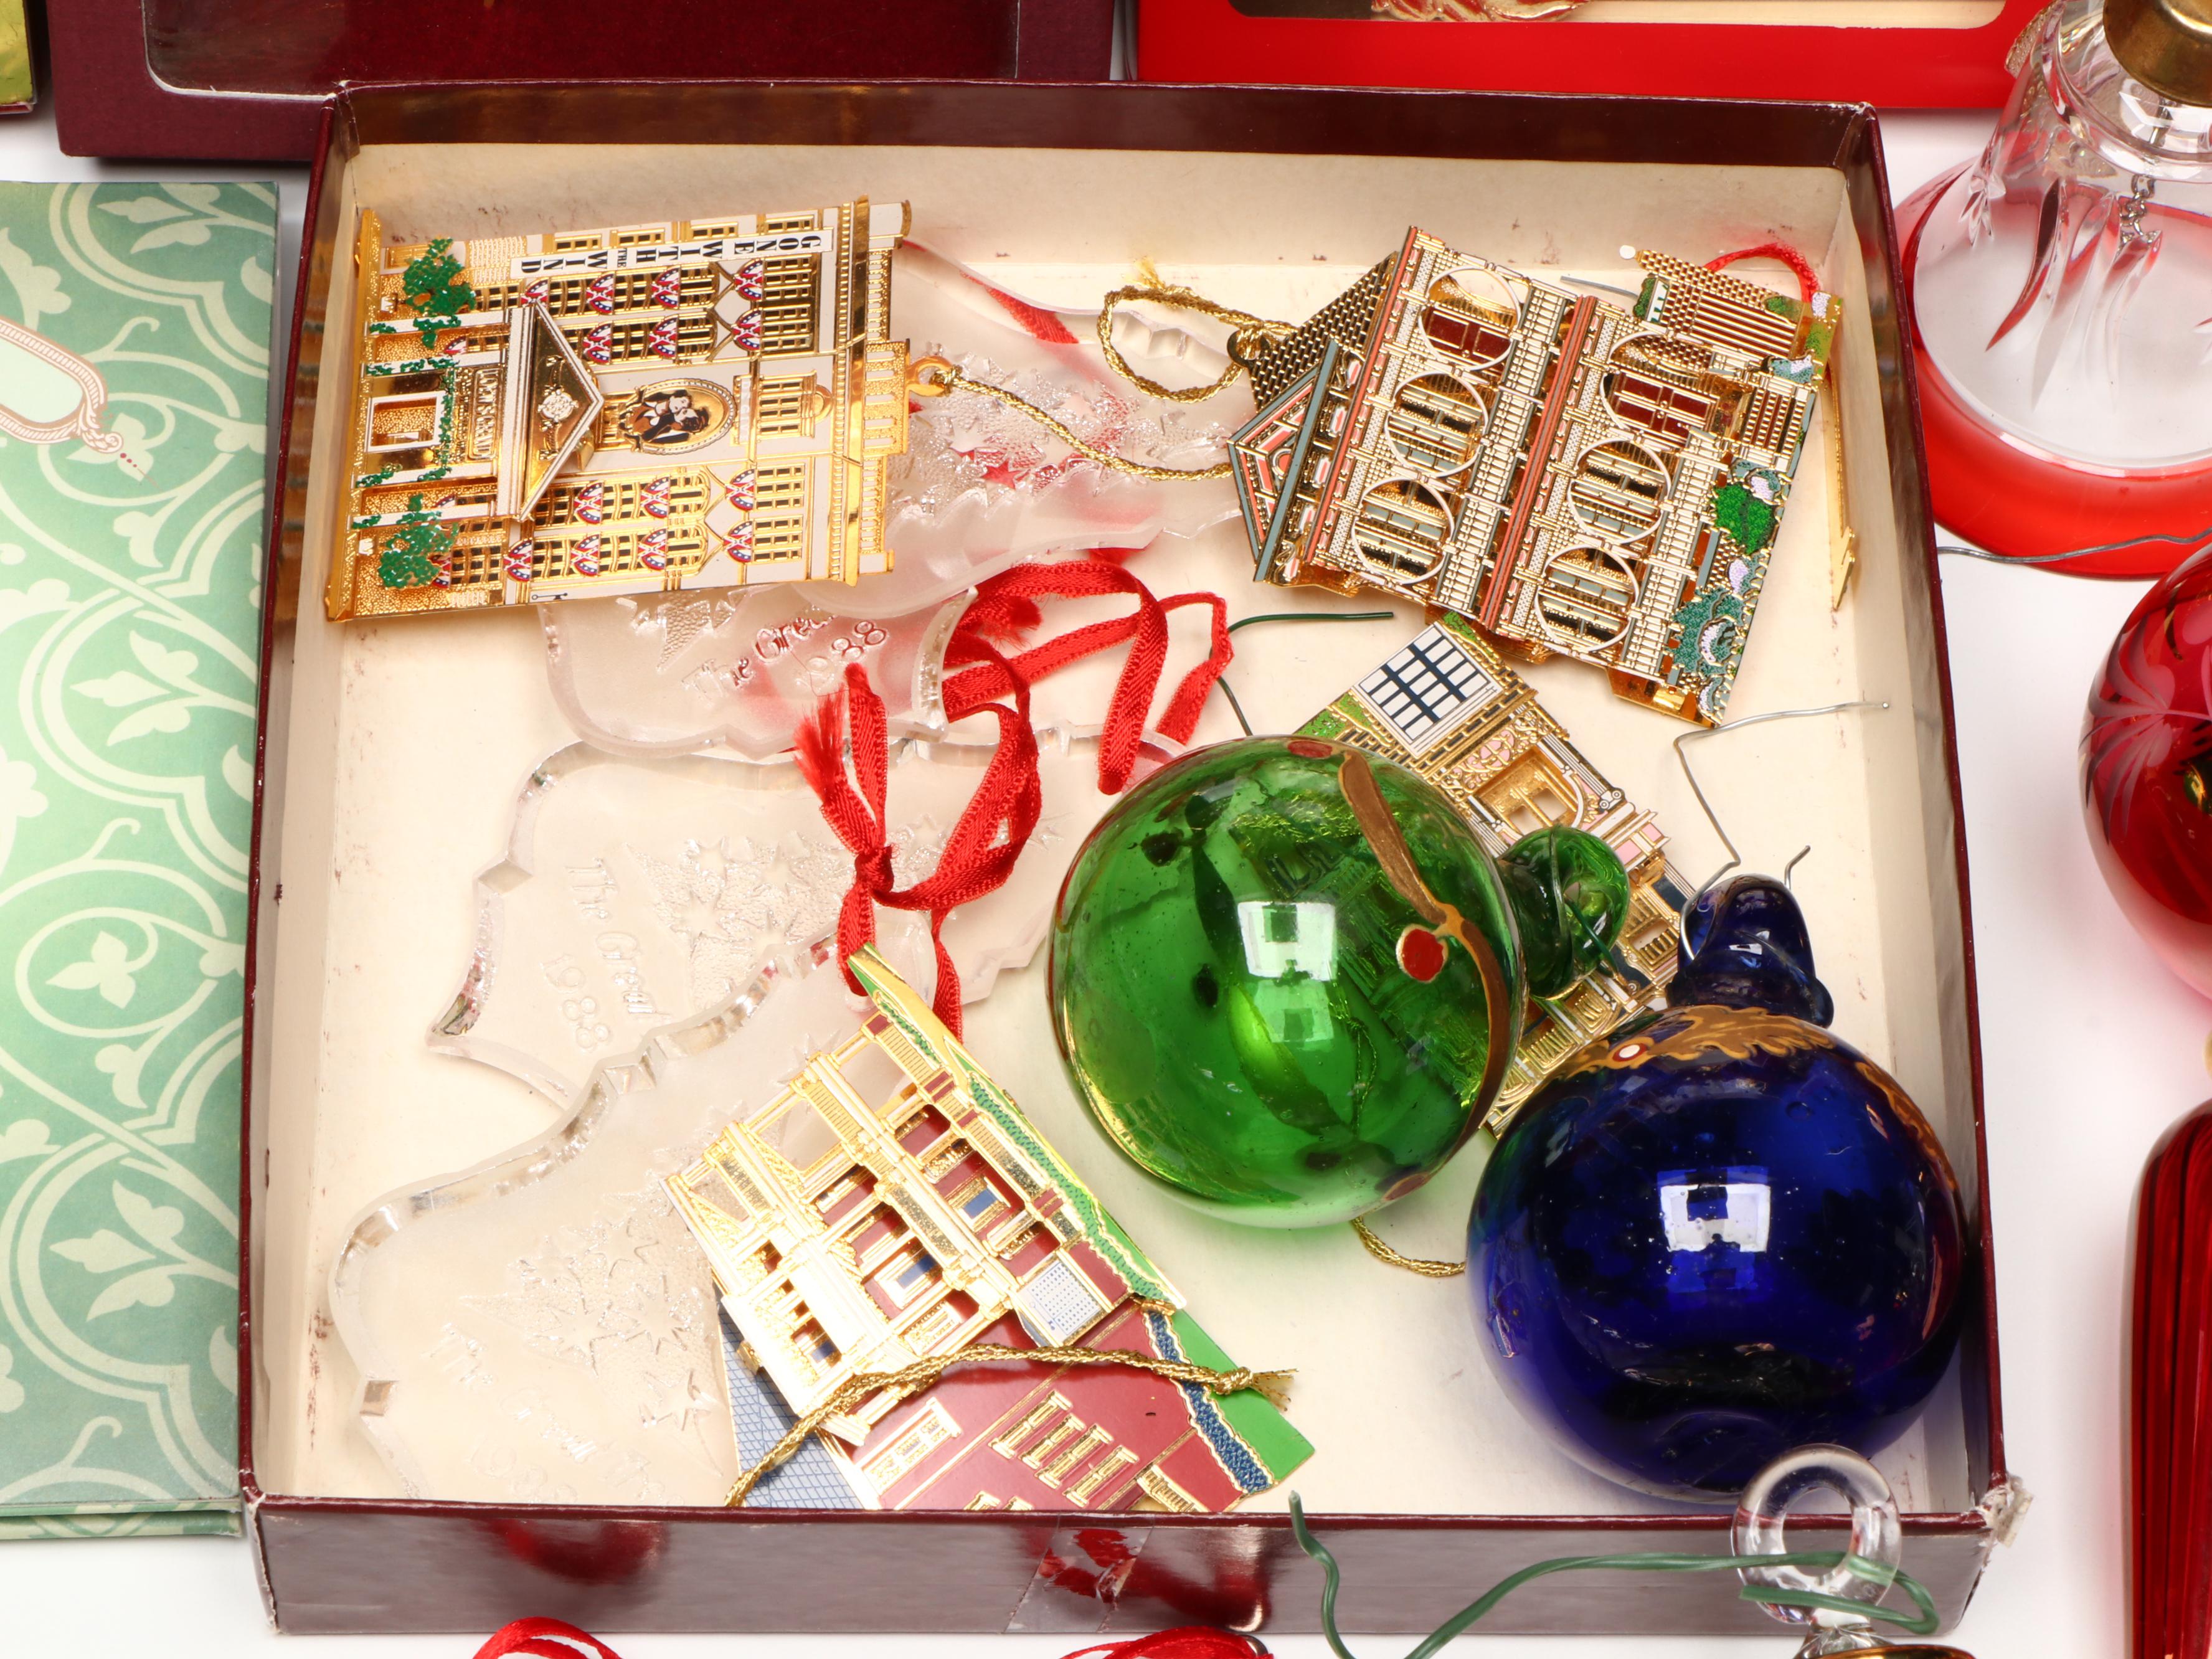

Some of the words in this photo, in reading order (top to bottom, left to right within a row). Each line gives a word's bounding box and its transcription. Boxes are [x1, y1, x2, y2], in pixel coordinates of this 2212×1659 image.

[617, 247, 628, 268] THE
[636, 240, 724, 265] WITH
[734, 235, 823, 255] GONE
[521, 249, 609, 275] WIND
[565, 857, 619, 920] The
[595, 931, 673, 1018] Great
[539, 954, 613, 1052] 1988
